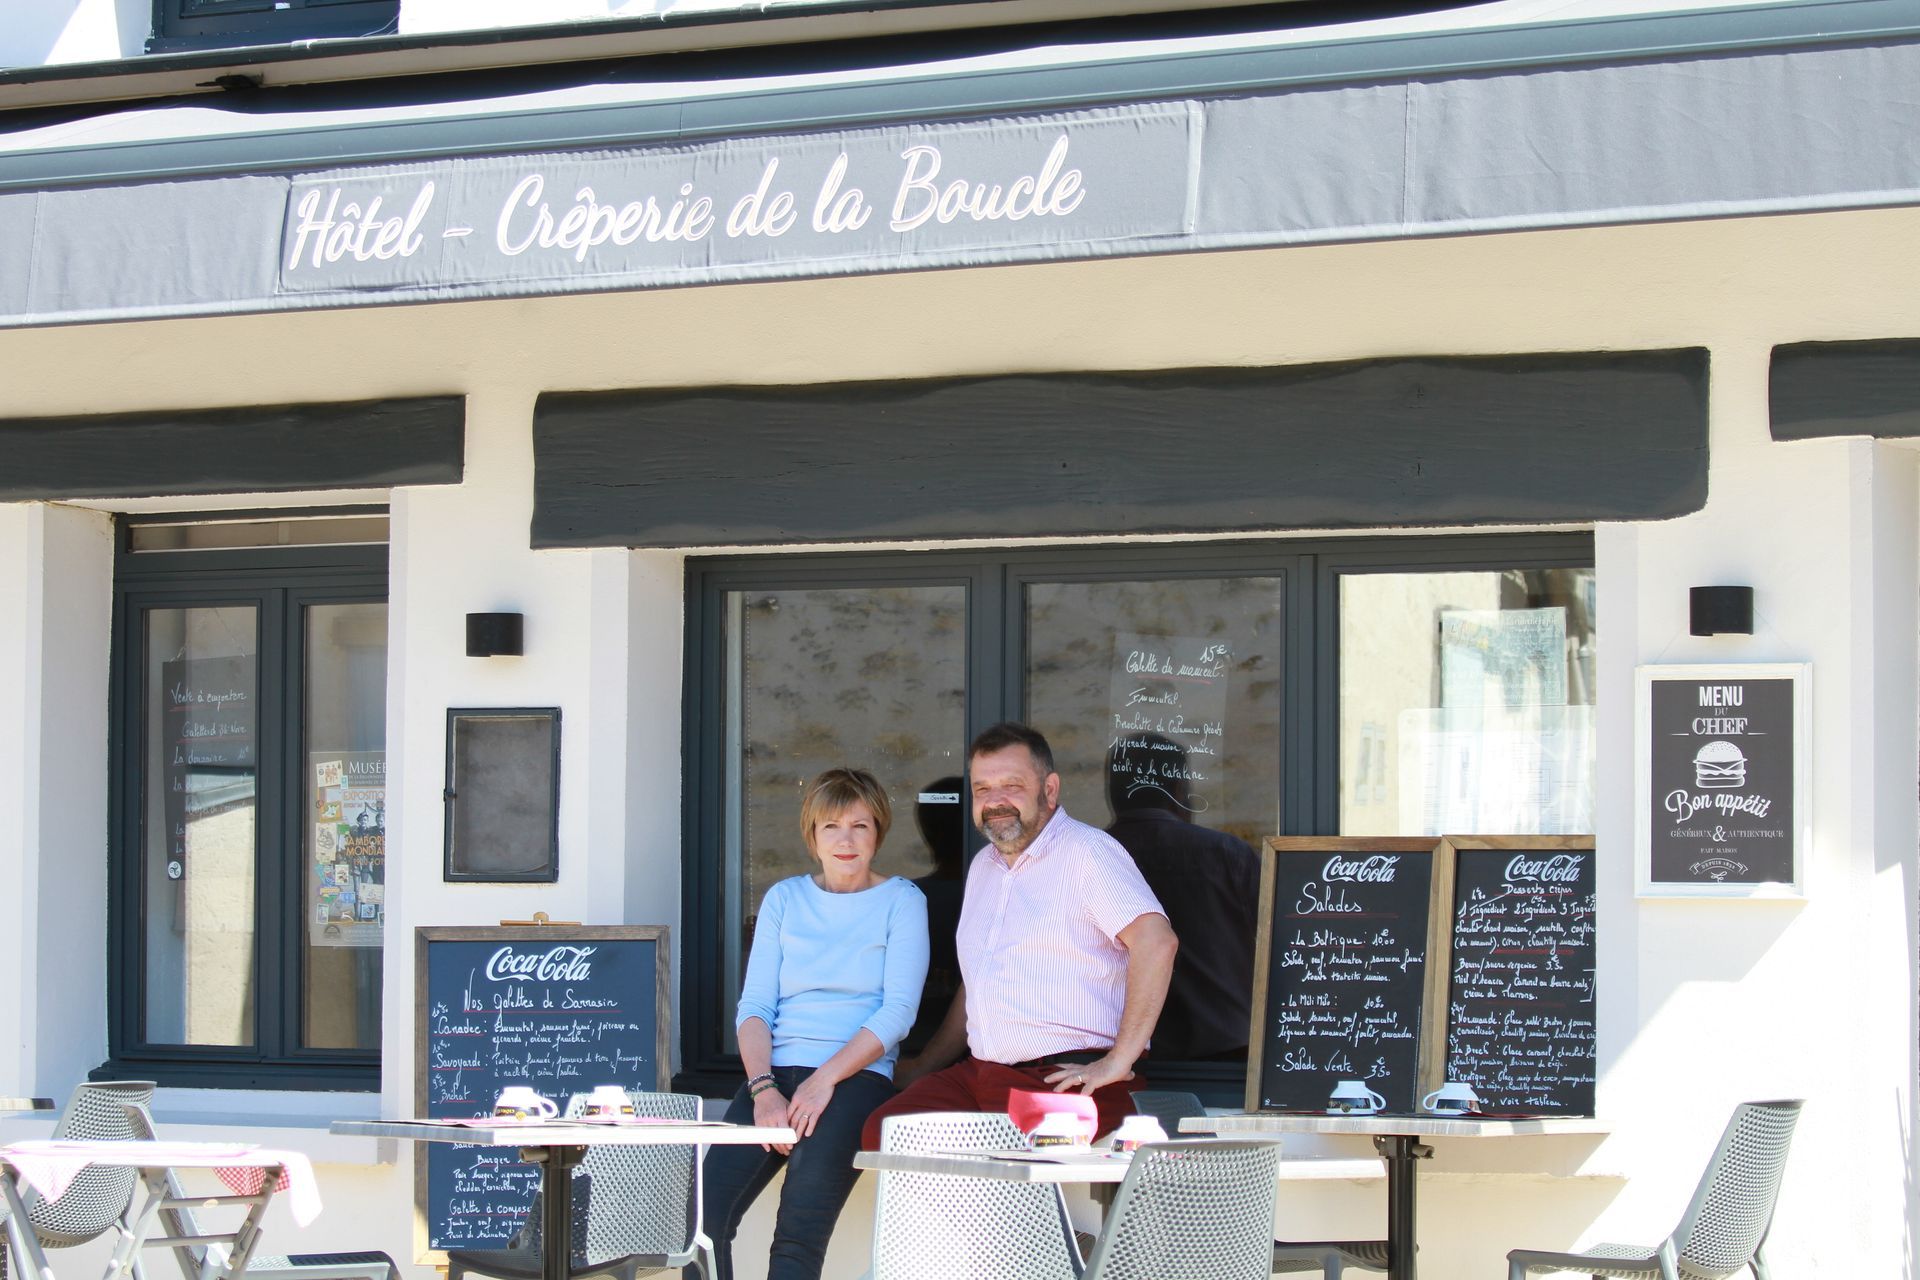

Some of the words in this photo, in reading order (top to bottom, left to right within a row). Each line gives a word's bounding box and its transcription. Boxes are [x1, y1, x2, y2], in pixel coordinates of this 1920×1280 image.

[288, 181, 436, 270] Hôtel
[496, 170, 716, 263] Crêperie
[726, 157, 797, 238] de
[811, 151, 873, 233] la
[888, 134, 1087, 234] Boucle
[1126, 651, 1158, 673] Galette
[1699, 685, 1743, 707] MENU
[1714, 707, 1728, 717] DU
[1692, 717, 1748, 735] CHEF
[1147, 759, 1157, 776] la
[1665, 789, 1712, 824] Bon
[1715, 793, 1771, 818] appétit
[1712, 825, 1727, 842] &
[1728, 829, 1784, 839] AUTHENTIQUE
[346, 846, 386, 857] MONDIA
[1322, 855, 1401, 883] Coca-Cola
[1505, 854, 1585, 882] Coca-Cola
[1296, 882, 1362, 914] Salades
[486, 946, 598, 981] Coca-Cola
[543, 988, 554, 1008] de
[487, 1203, 493, 1213] à
